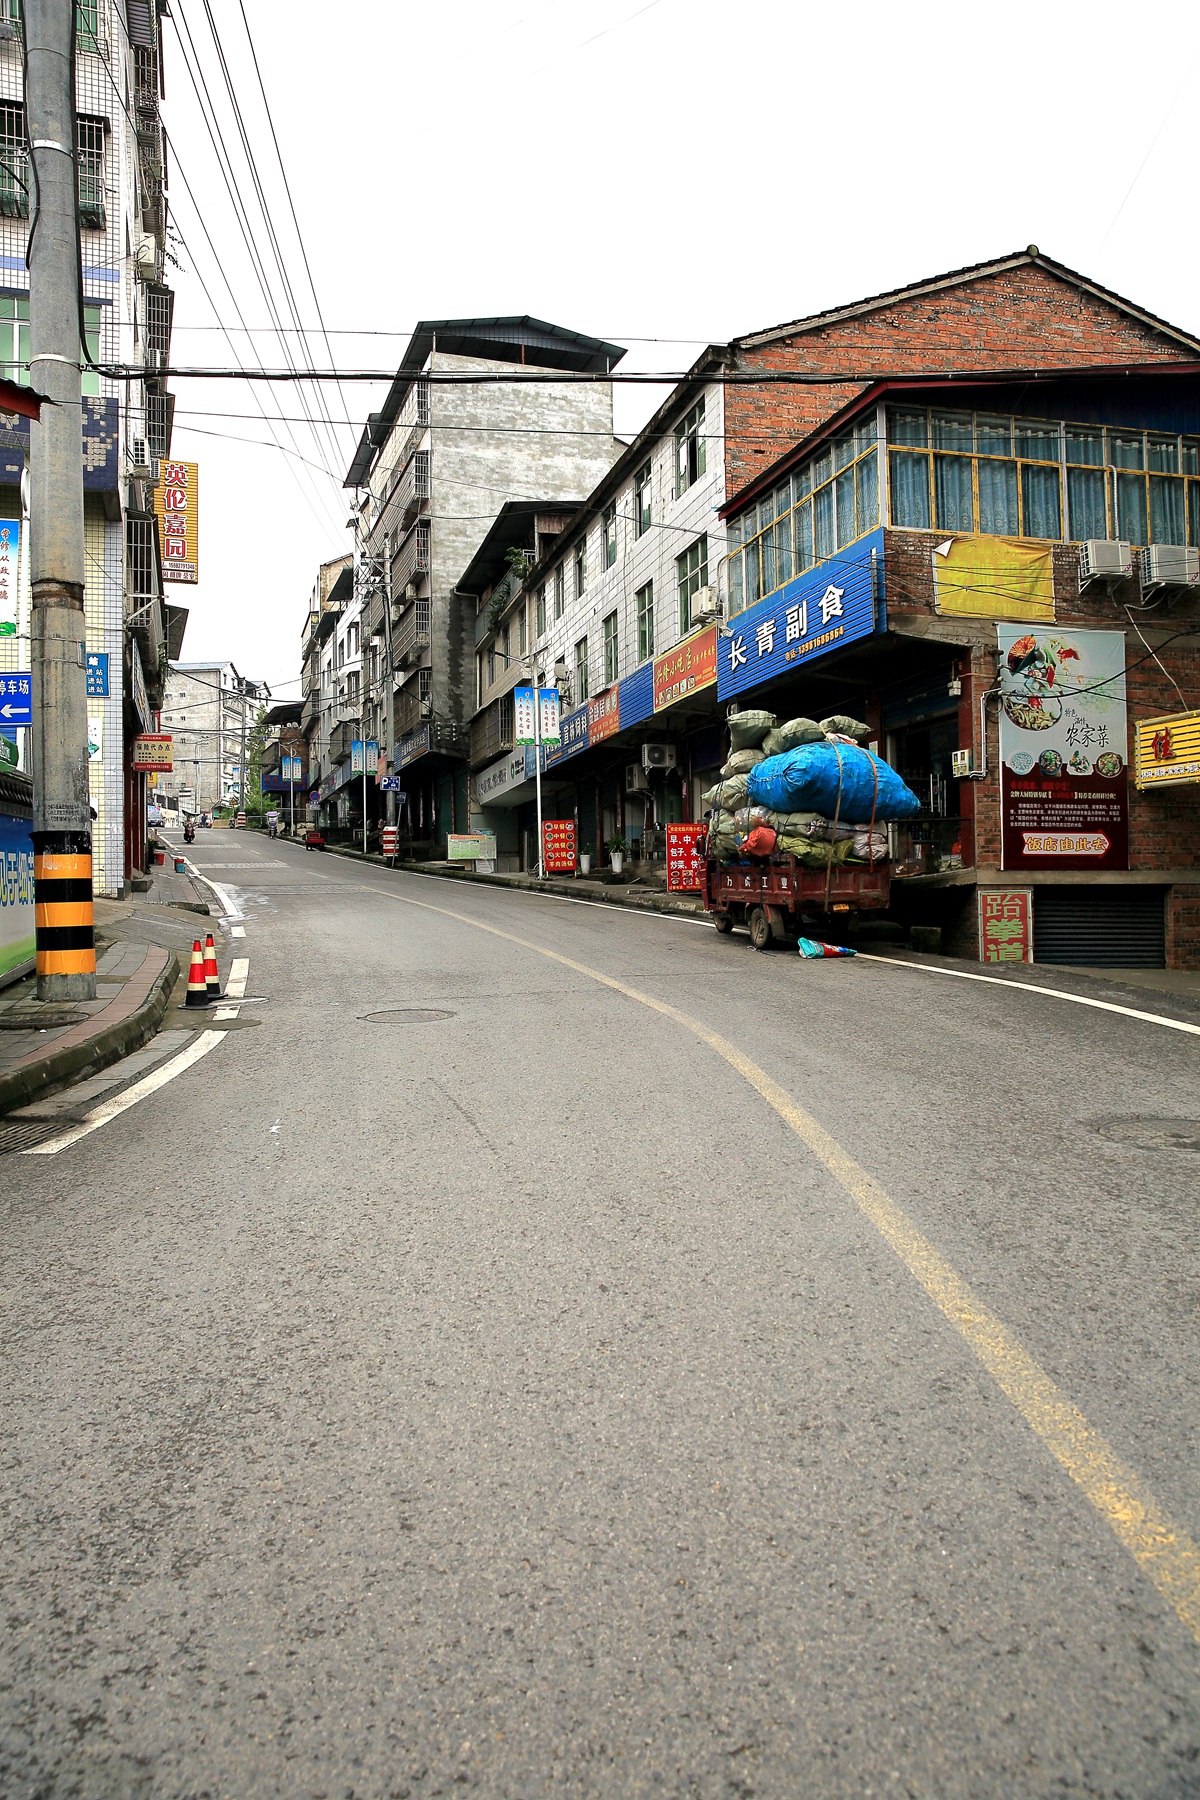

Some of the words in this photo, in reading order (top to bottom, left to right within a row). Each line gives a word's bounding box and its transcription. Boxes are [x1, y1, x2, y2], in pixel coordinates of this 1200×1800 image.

[164, 463, 188, 560] 英伦嘉园
[727, 584, 845, 671] 长青副食
[136, 743, 170, 751] 保险代办点
[1065, 723, 1109, 748] 农家菜
[1151, 726, 1174, 761] 佳
[1026, 837, 1107, 852] 饭店由此去
[986, 894, 1024, 963] 跆拳道
